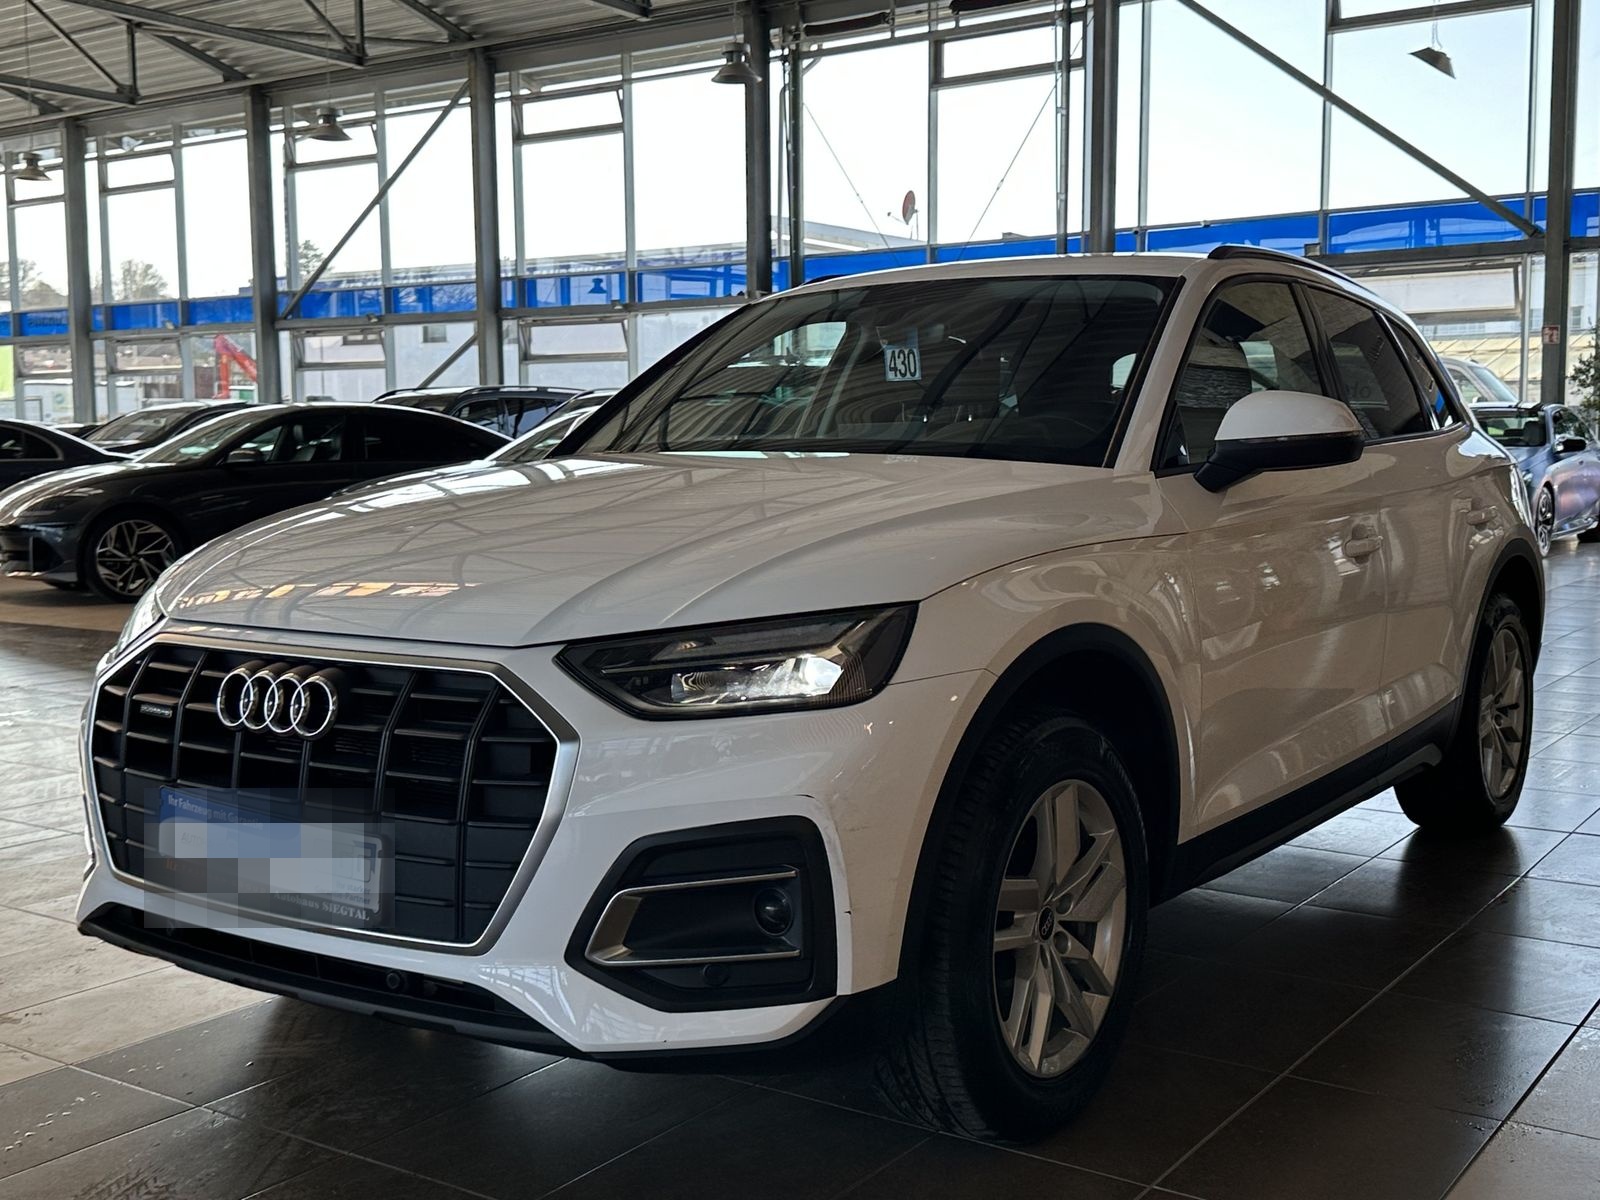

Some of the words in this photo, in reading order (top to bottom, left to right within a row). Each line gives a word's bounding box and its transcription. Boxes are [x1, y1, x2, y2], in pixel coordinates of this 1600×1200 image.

[889, 349, 917, 377] 430
[168, 793, 178, 807] Ihr
[178, 797, 213, 819] Fahrzeug
[213, 809, 227, 821] mit
[322, 901, 370, 921] SIEGTAL
